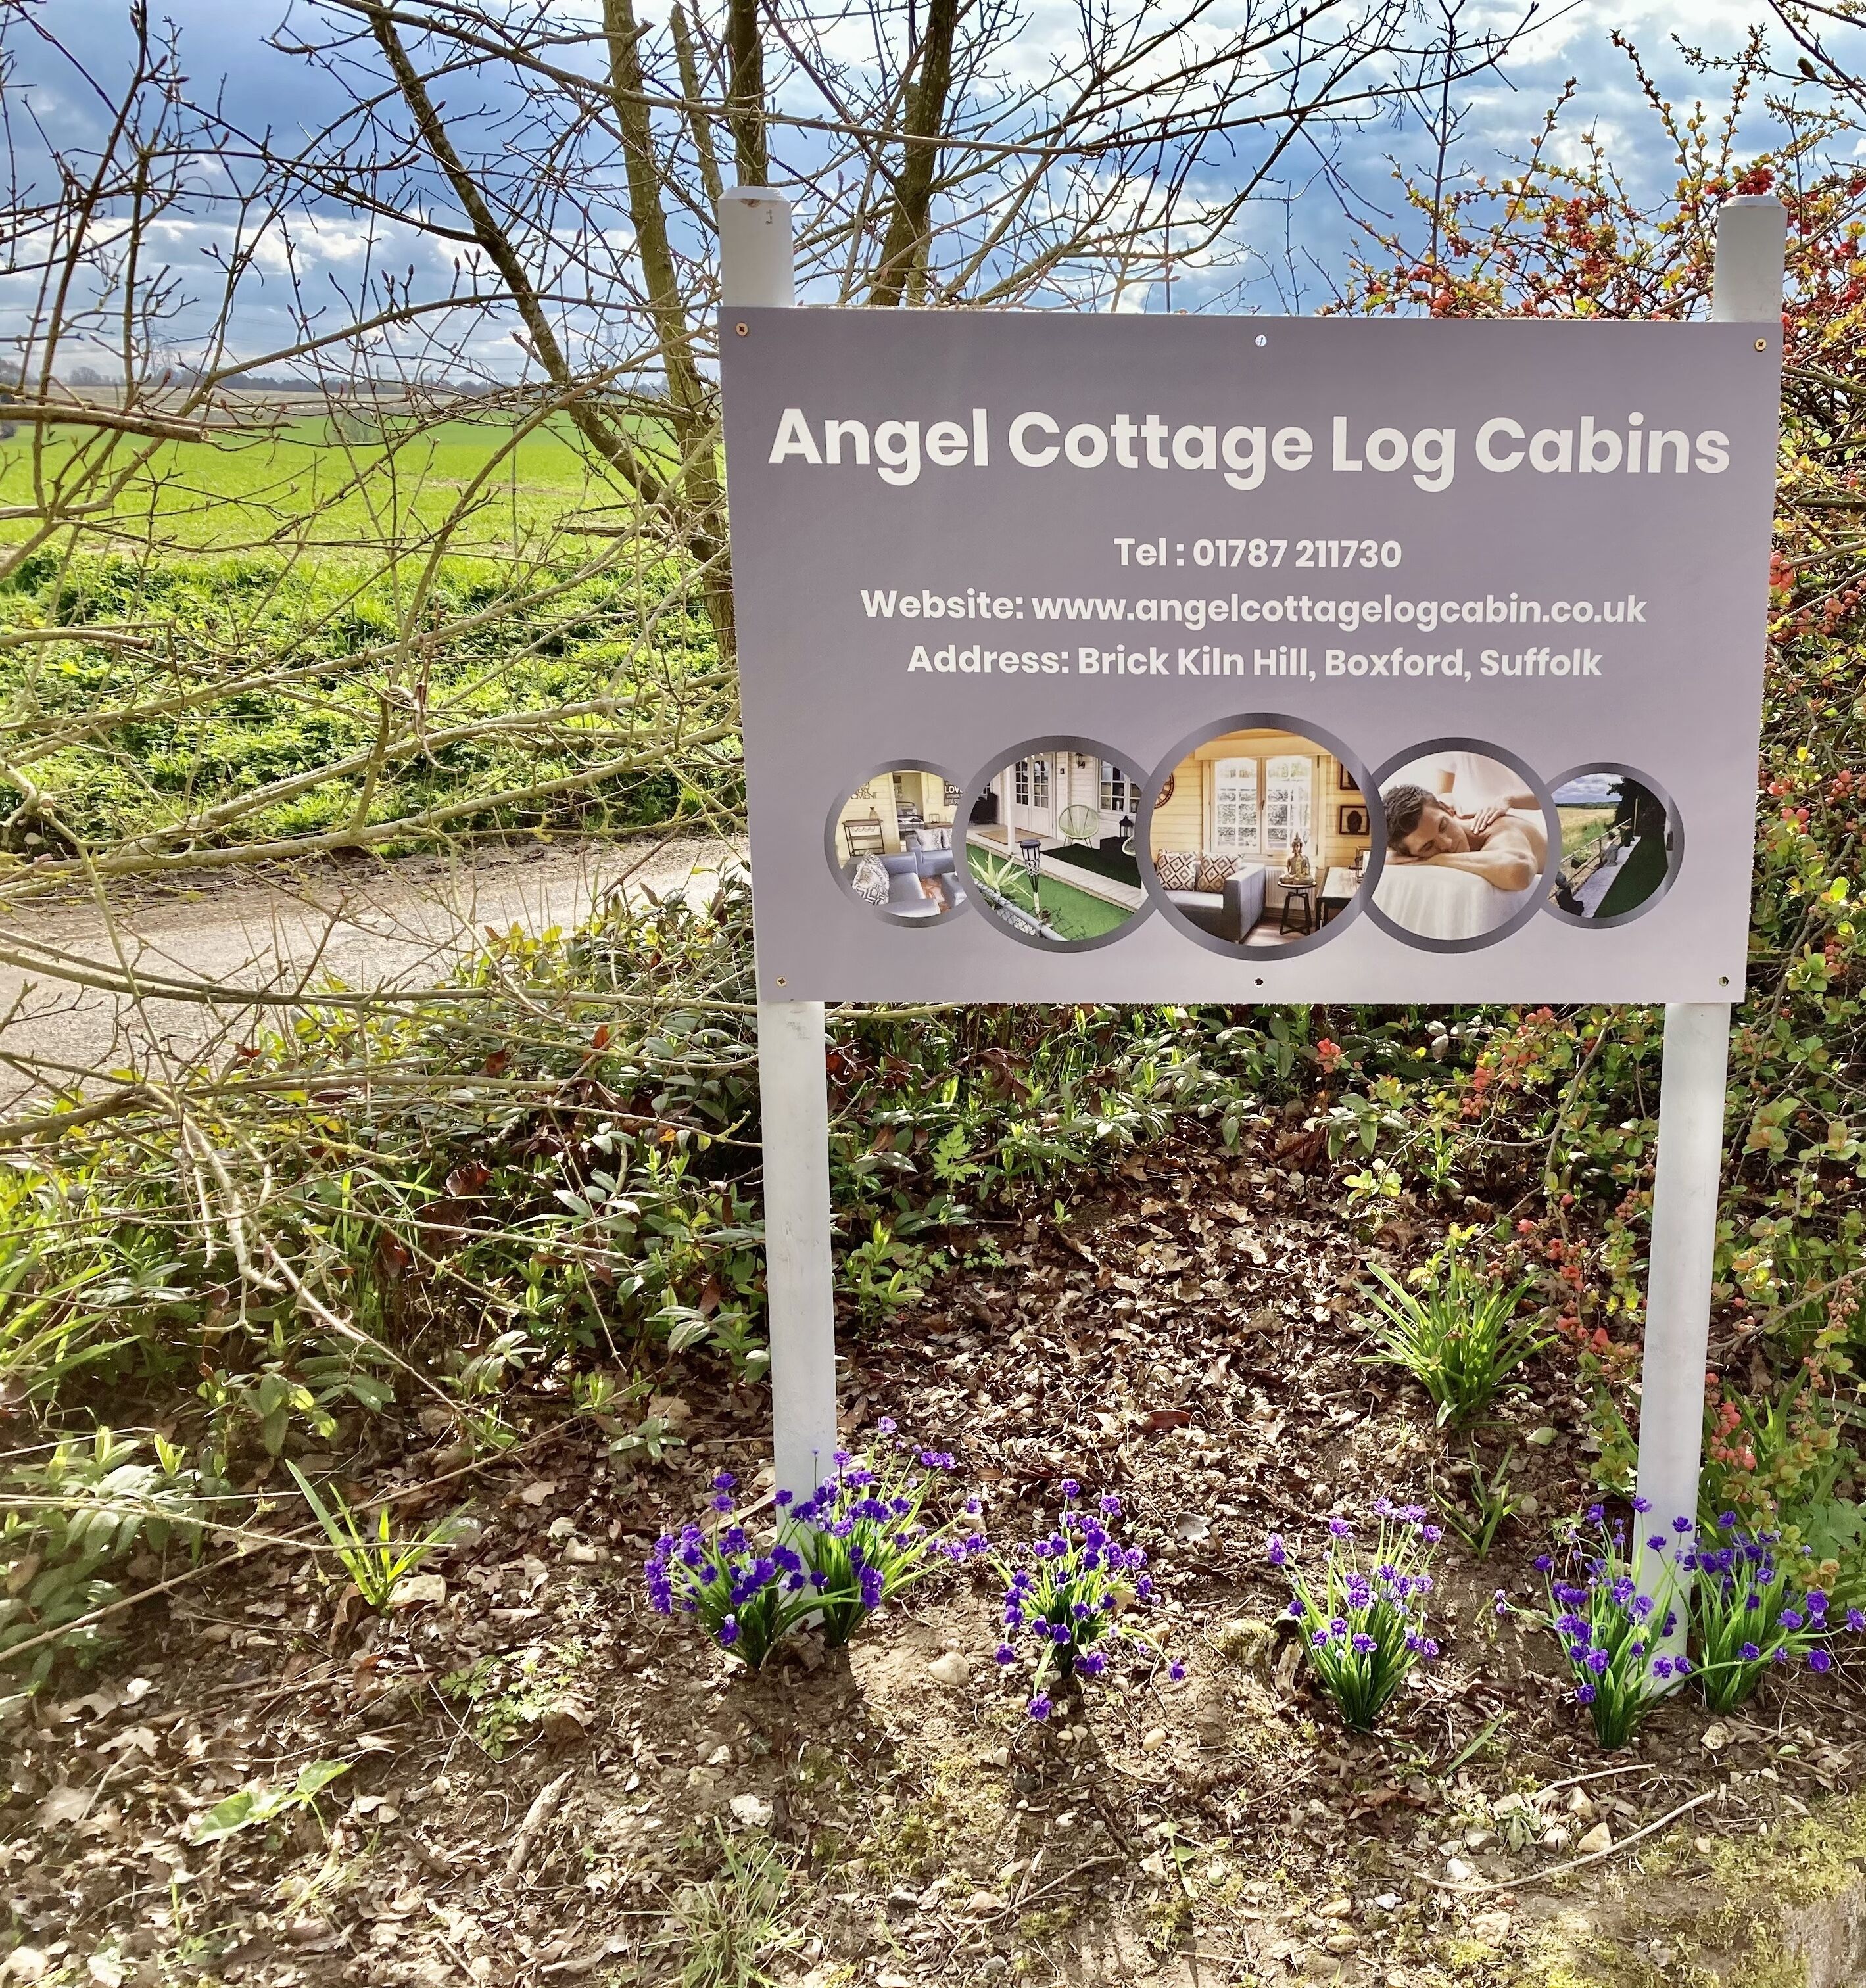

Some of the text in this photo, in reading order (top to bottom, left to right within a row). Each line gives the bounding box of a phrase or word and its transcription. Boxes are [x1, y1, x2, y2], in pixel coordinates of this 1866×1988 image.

[768, 408, 1730, 492] Angel Cottage Log Cabins
[1114, 537, 1167, 566] Tel
[1193, 538, 1288, 567] 01787
[1295, 539, 1402, 568] 211730
[860, 588, 1648, 632] Website: www.angelcottagelogcabin.co.uk
[907, 644, 1603, 682] Address: Brick Kiln Hill, Boxford, Suffolk
